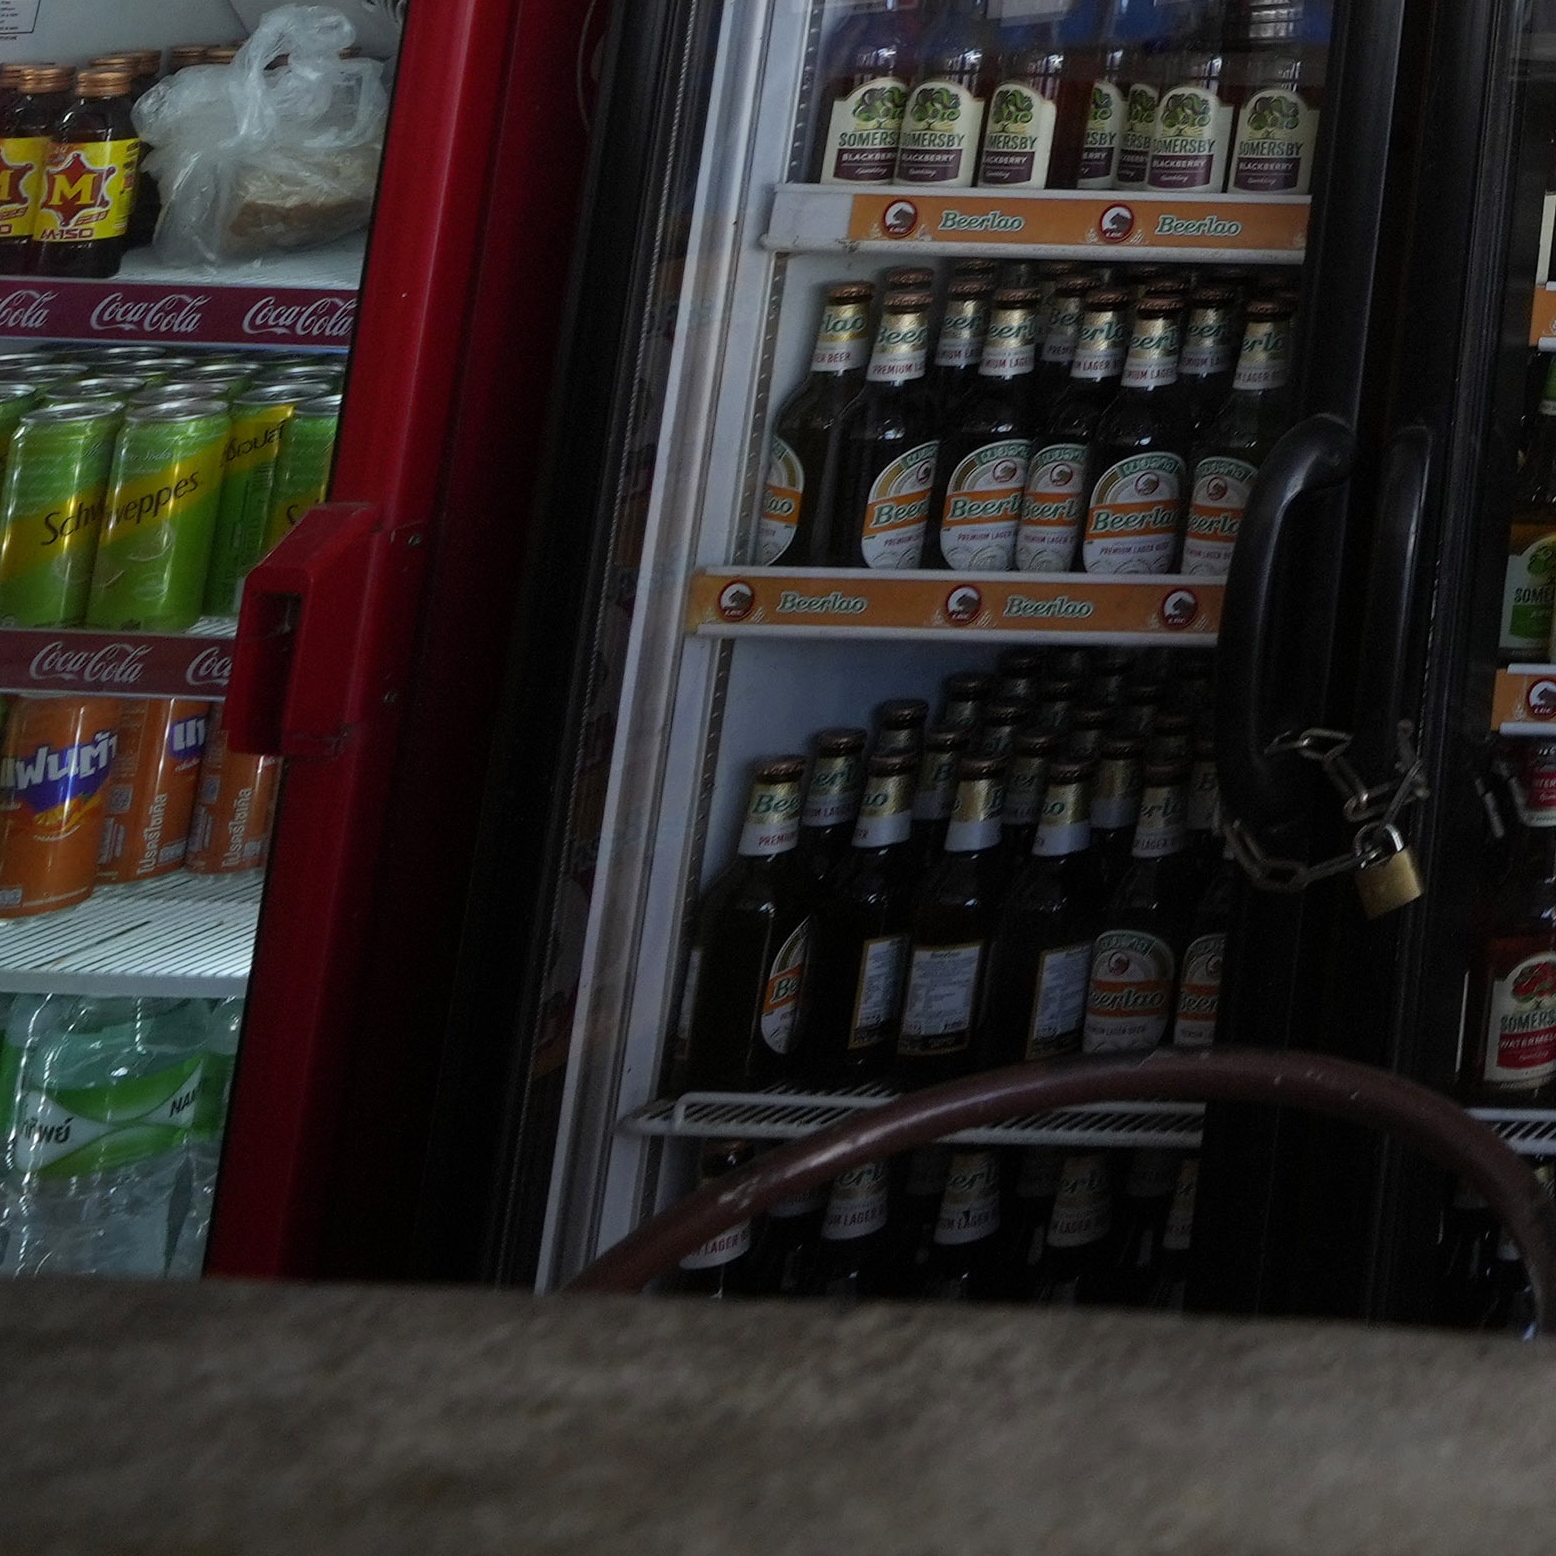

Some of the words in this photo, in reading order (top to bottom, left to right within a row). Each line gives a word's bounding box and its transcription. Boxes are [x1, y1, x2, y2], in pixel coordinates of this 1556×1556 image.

[49, 172, 98, 208] M
[938, 209, 1026, 232] Beerlao
[1154, 214, 1243, 238] Beerlao
[89, 291, 213, 335] Coca-Cola
[774, 591, 869, 616] Beerlao
[1003, 594, 1095, 619] Beerlao
[28, 642, 153, 684] Coca-Cola
